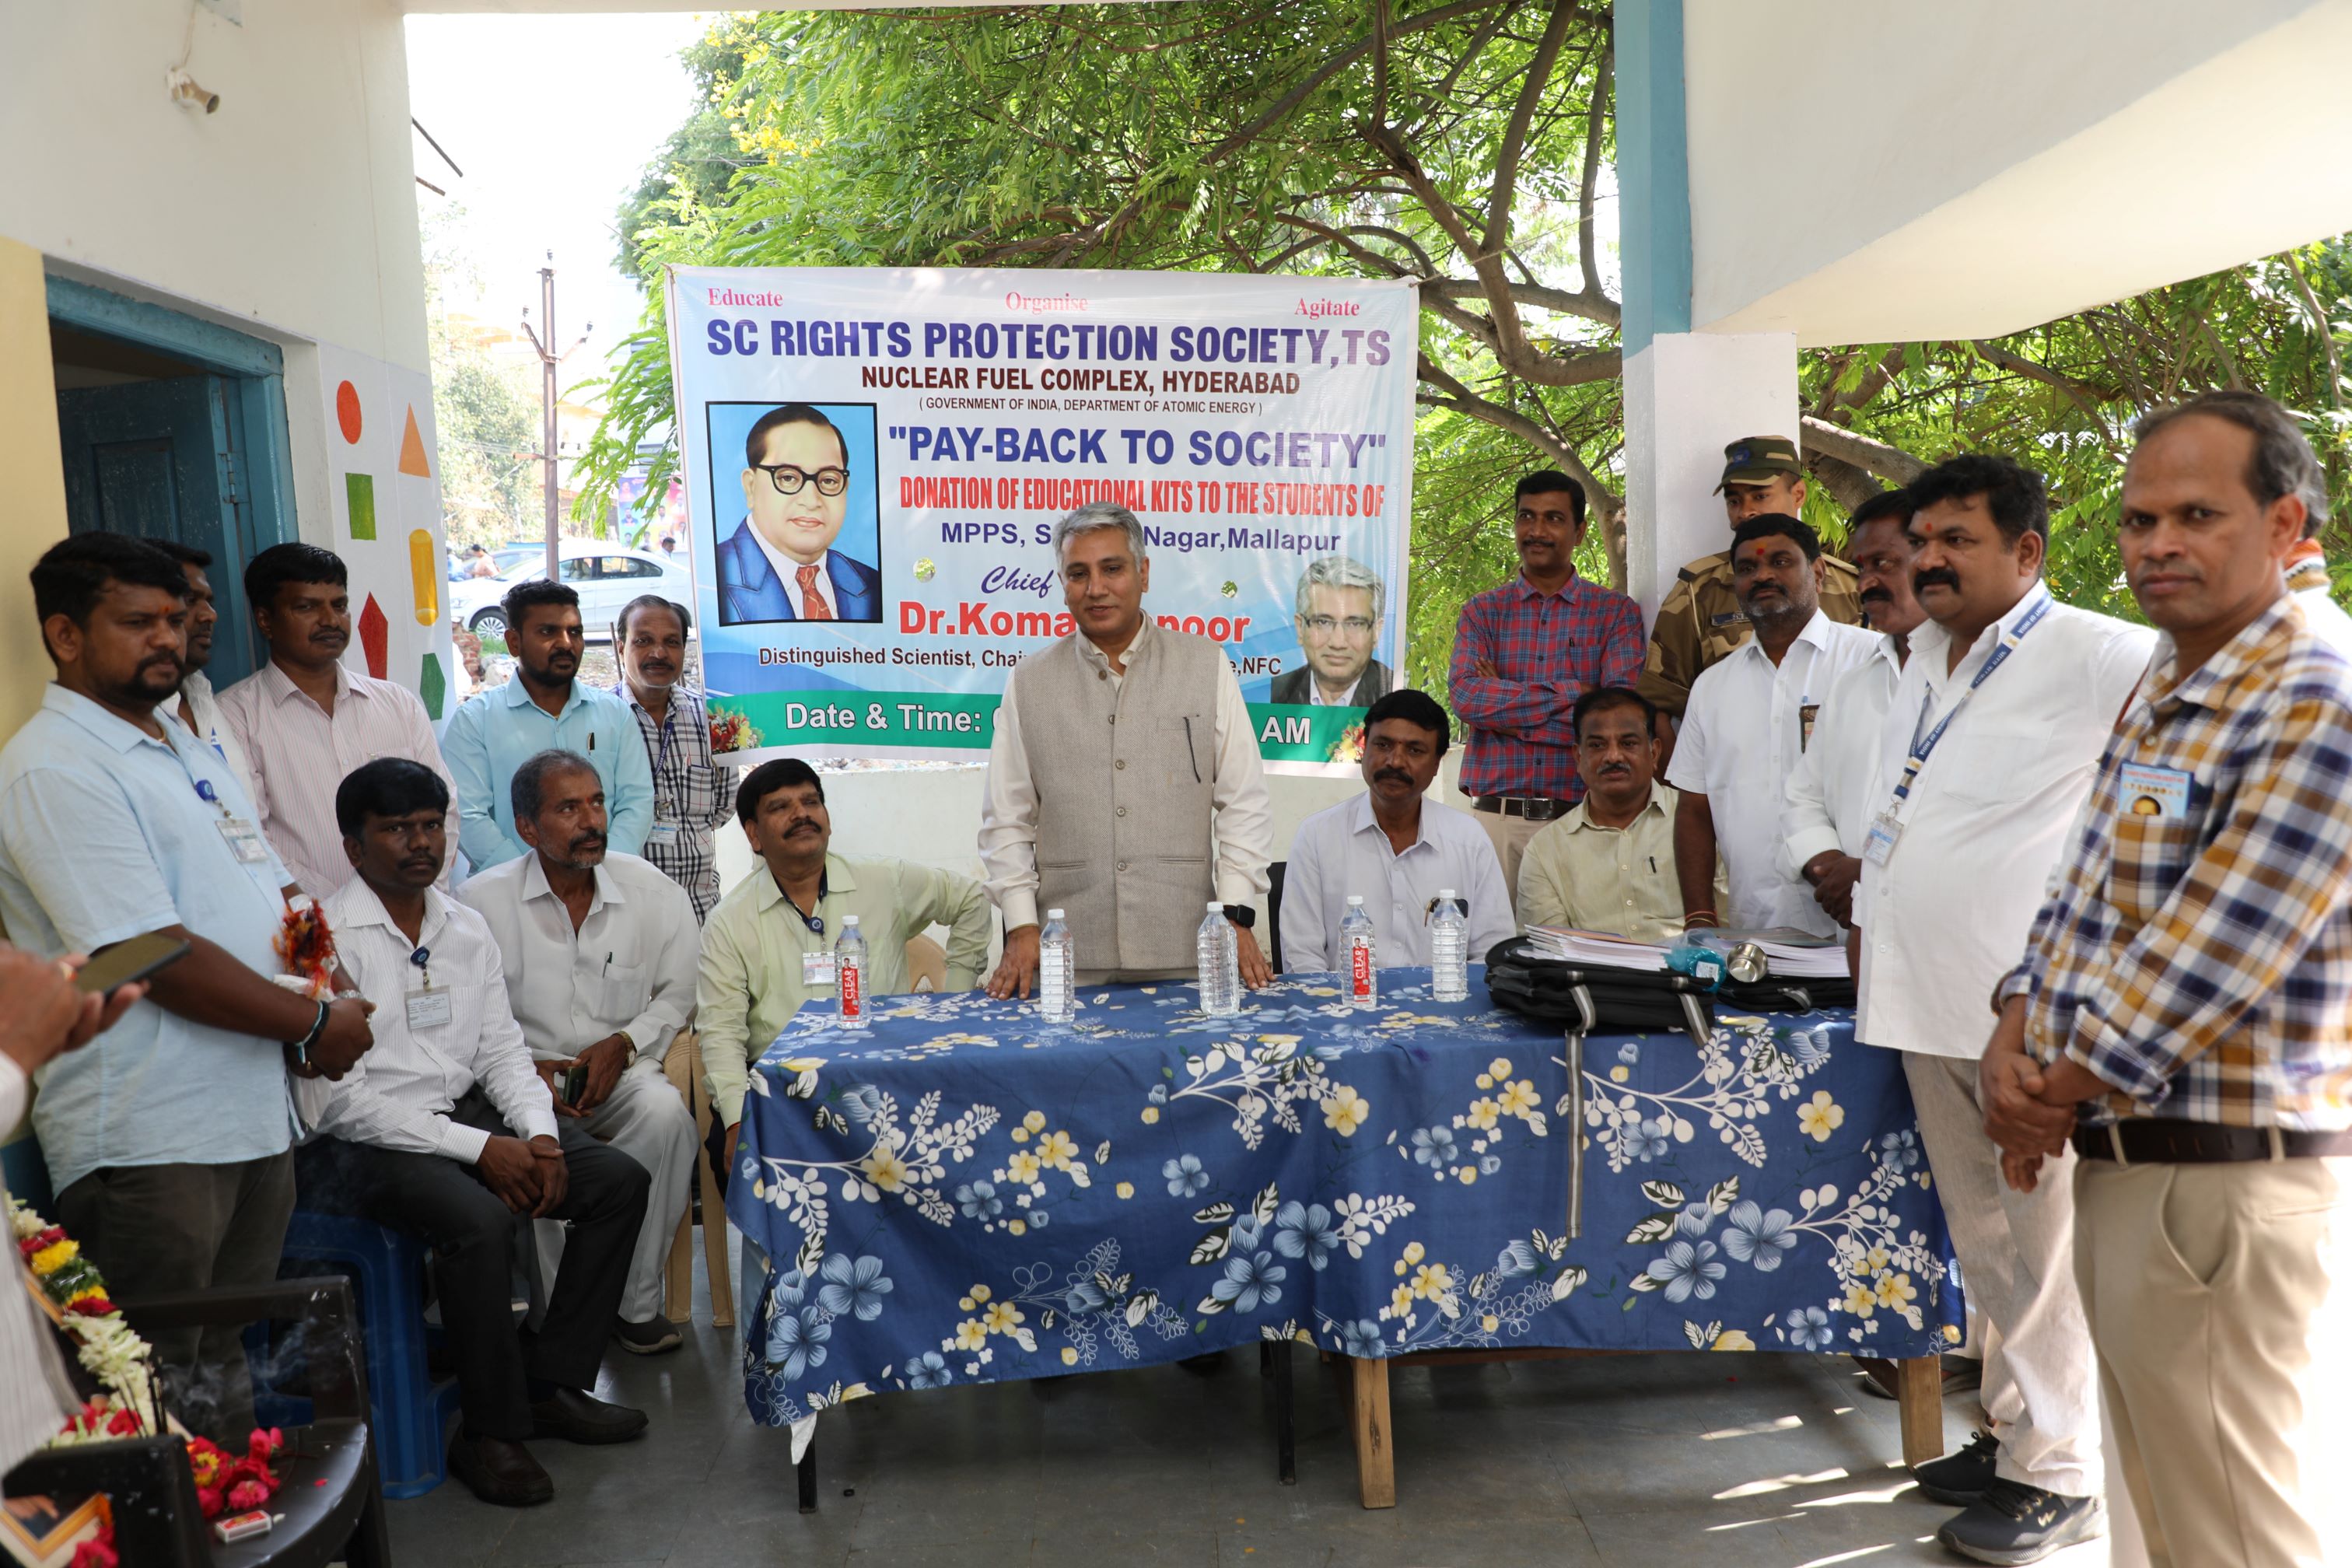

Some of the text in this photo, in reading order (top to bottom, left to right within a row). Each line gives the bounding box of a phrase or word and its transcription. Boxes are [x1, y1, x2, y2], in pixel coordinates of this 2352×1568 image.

[707, 287, 783, 307] Educate
[1006, 292, 1088, 314] Organise
[1294, 298, 1360, 320] Agitate
[707, 319, 758, 355] SC
[771, 320, 912, 358] RIGHTS
[924, 322, 1157, 361] PROTECTION
[862, 366, 1300, 397] NUCLEAR FUEL COMPLEX, HYDERABAD
[1009, 398, 1024, 410] OF
[1027, 399, 1061, 412] INDIA,
[1064, 400, 1140, 411] DEPARTMENT
[1144, 401, 1159, 412] OF
[1162, 401, 1206, 413] ATOMIC
[889, 425, 1386, 468] "PAY-BACK TO SOCIETY"
[900, 476, 1385, 517] DONATION OF EDUCATIONAL KITS TO THE STUDENTS OF
[942, 523, 1025, 548] MPPS,
[981, 565, 1054, 599] Chief
[899, 600, 1078, 637] Dr.Koma
[759, 647, 885, 667] Distinguished
[892, 648, 975, 668] Scientist,
[786, 702, 856, 730] Date
[865, 702, 888, 730] &
[897, 703, 982, 733] Time:
[1259, 716, 1311, 744] AM
[1355, 949, 1364, 979] CLEAR
[845, 970, 854, 999] CLEAR
